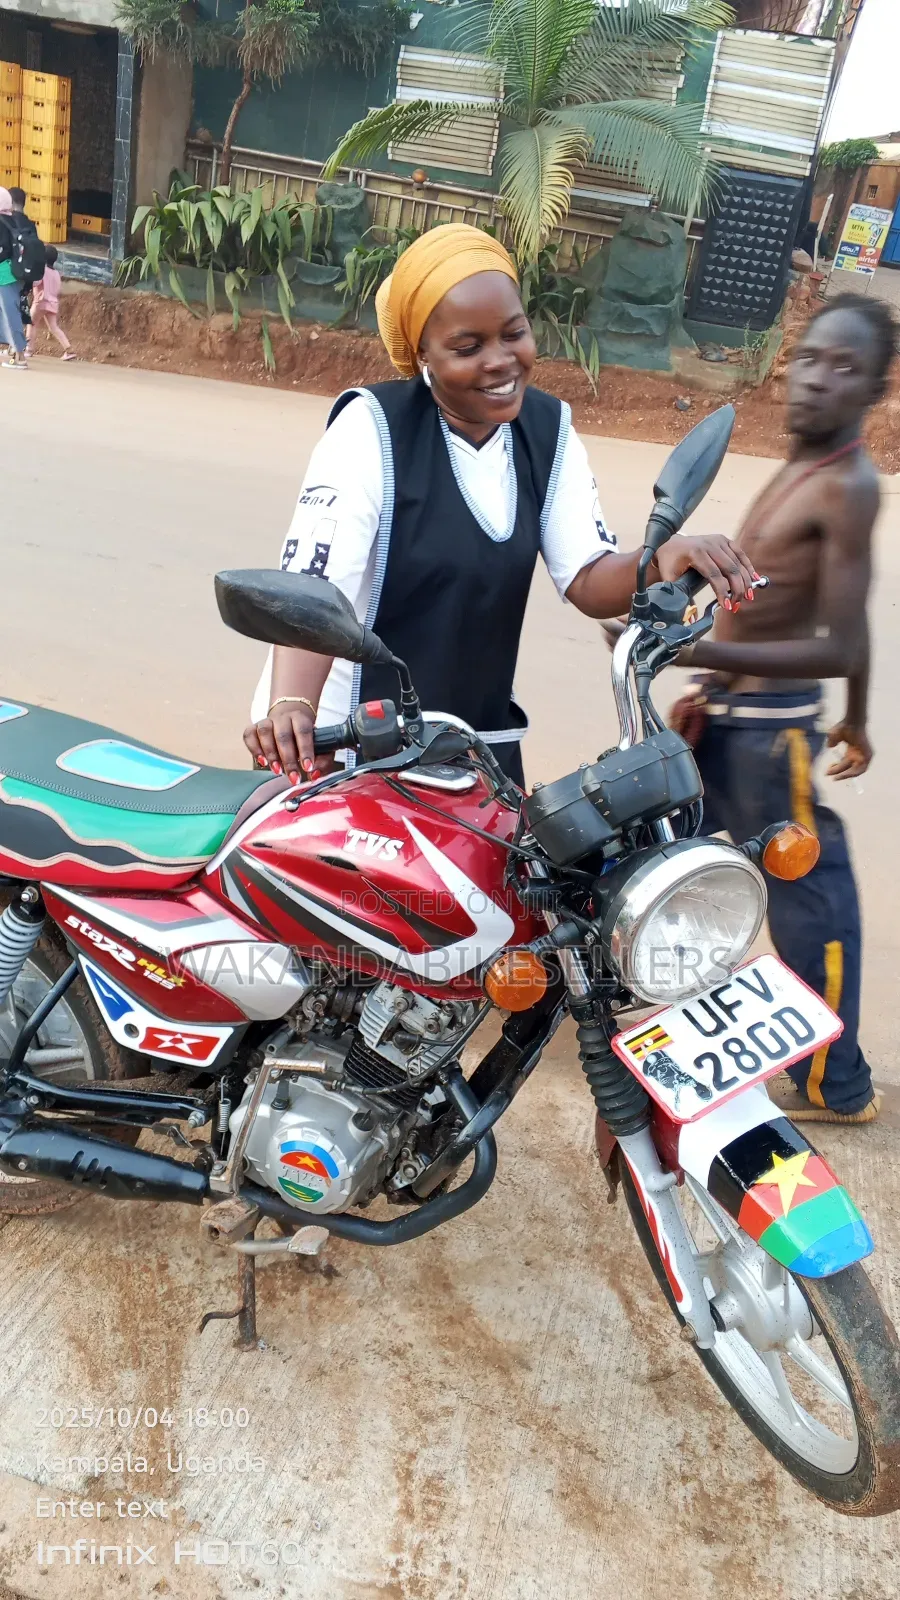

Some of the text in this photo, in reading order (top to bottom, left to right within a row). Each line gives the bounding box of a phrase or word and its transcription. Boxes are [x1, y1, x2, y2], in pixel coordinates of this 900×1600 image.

[858, 256, 878, 264] airtel
[343, 829, 404, 861] TVS
[142, 970, 176, 990] 125
[682, 968, 775, 1037] UFV
